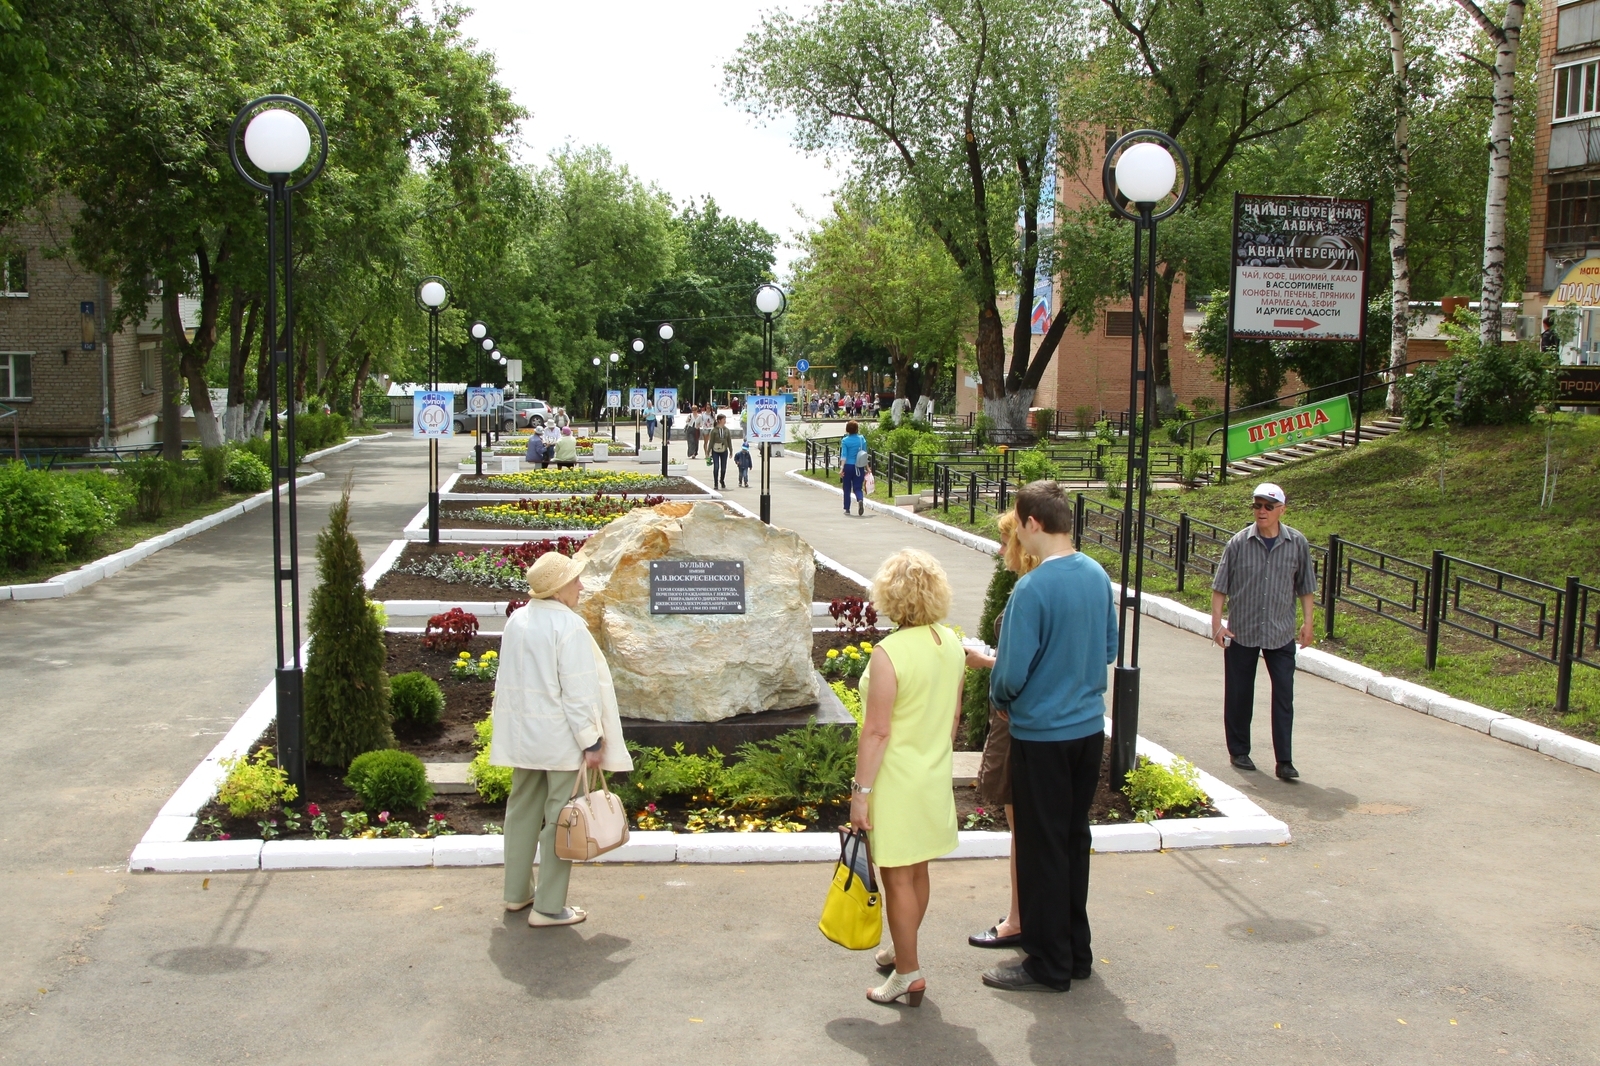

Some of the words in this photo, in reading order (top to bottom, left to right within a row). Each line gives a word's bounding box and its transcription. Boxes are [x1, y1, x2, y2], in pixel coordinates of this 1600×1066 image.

[1244, 203, 1361, 220] ЧАЙНО-КОФЕЙНАЯ
[1282, 219, 1324, 232] ЛАВКА
[1248, 245, 1355, 260] КОНДИТЕРСКИЙ
[1241, 270, 1261, 280] ЧАЙ,
[1262, 271, 1288, 280] КОФЕ,
[1289, 272, 1329, 282] ЦИКОРИЙ,
[1330, 274, 1358, 283] КАКАО
[1580, 267, 1600, 275] мага
[1266, 280, 1271, 288] В
[1272, 280, 1334, 290] АССОРТИМЕНТЕ
[1242, 288, 1283, 298] КОНФЕТЫ,
[1284, 290, 1318, 299] ПЕЧЕНЬЕ,
[1320, 291, 1356, 300] ПРЯНИКИ
[1260, 298, 1310, 308] МАРМЕЛАД,
[1311, 299, 1337, 308] ЗЕФИР
[1263, 307, 1294, 315] ДРУГИЕ
[1295, 307, 1341, 317] СЛАДОСТИ
[422, 409, 445, 424] 60
[756, 413, 777, 428] 60
[1247, 408, 1330, 443] ПТИЦА
